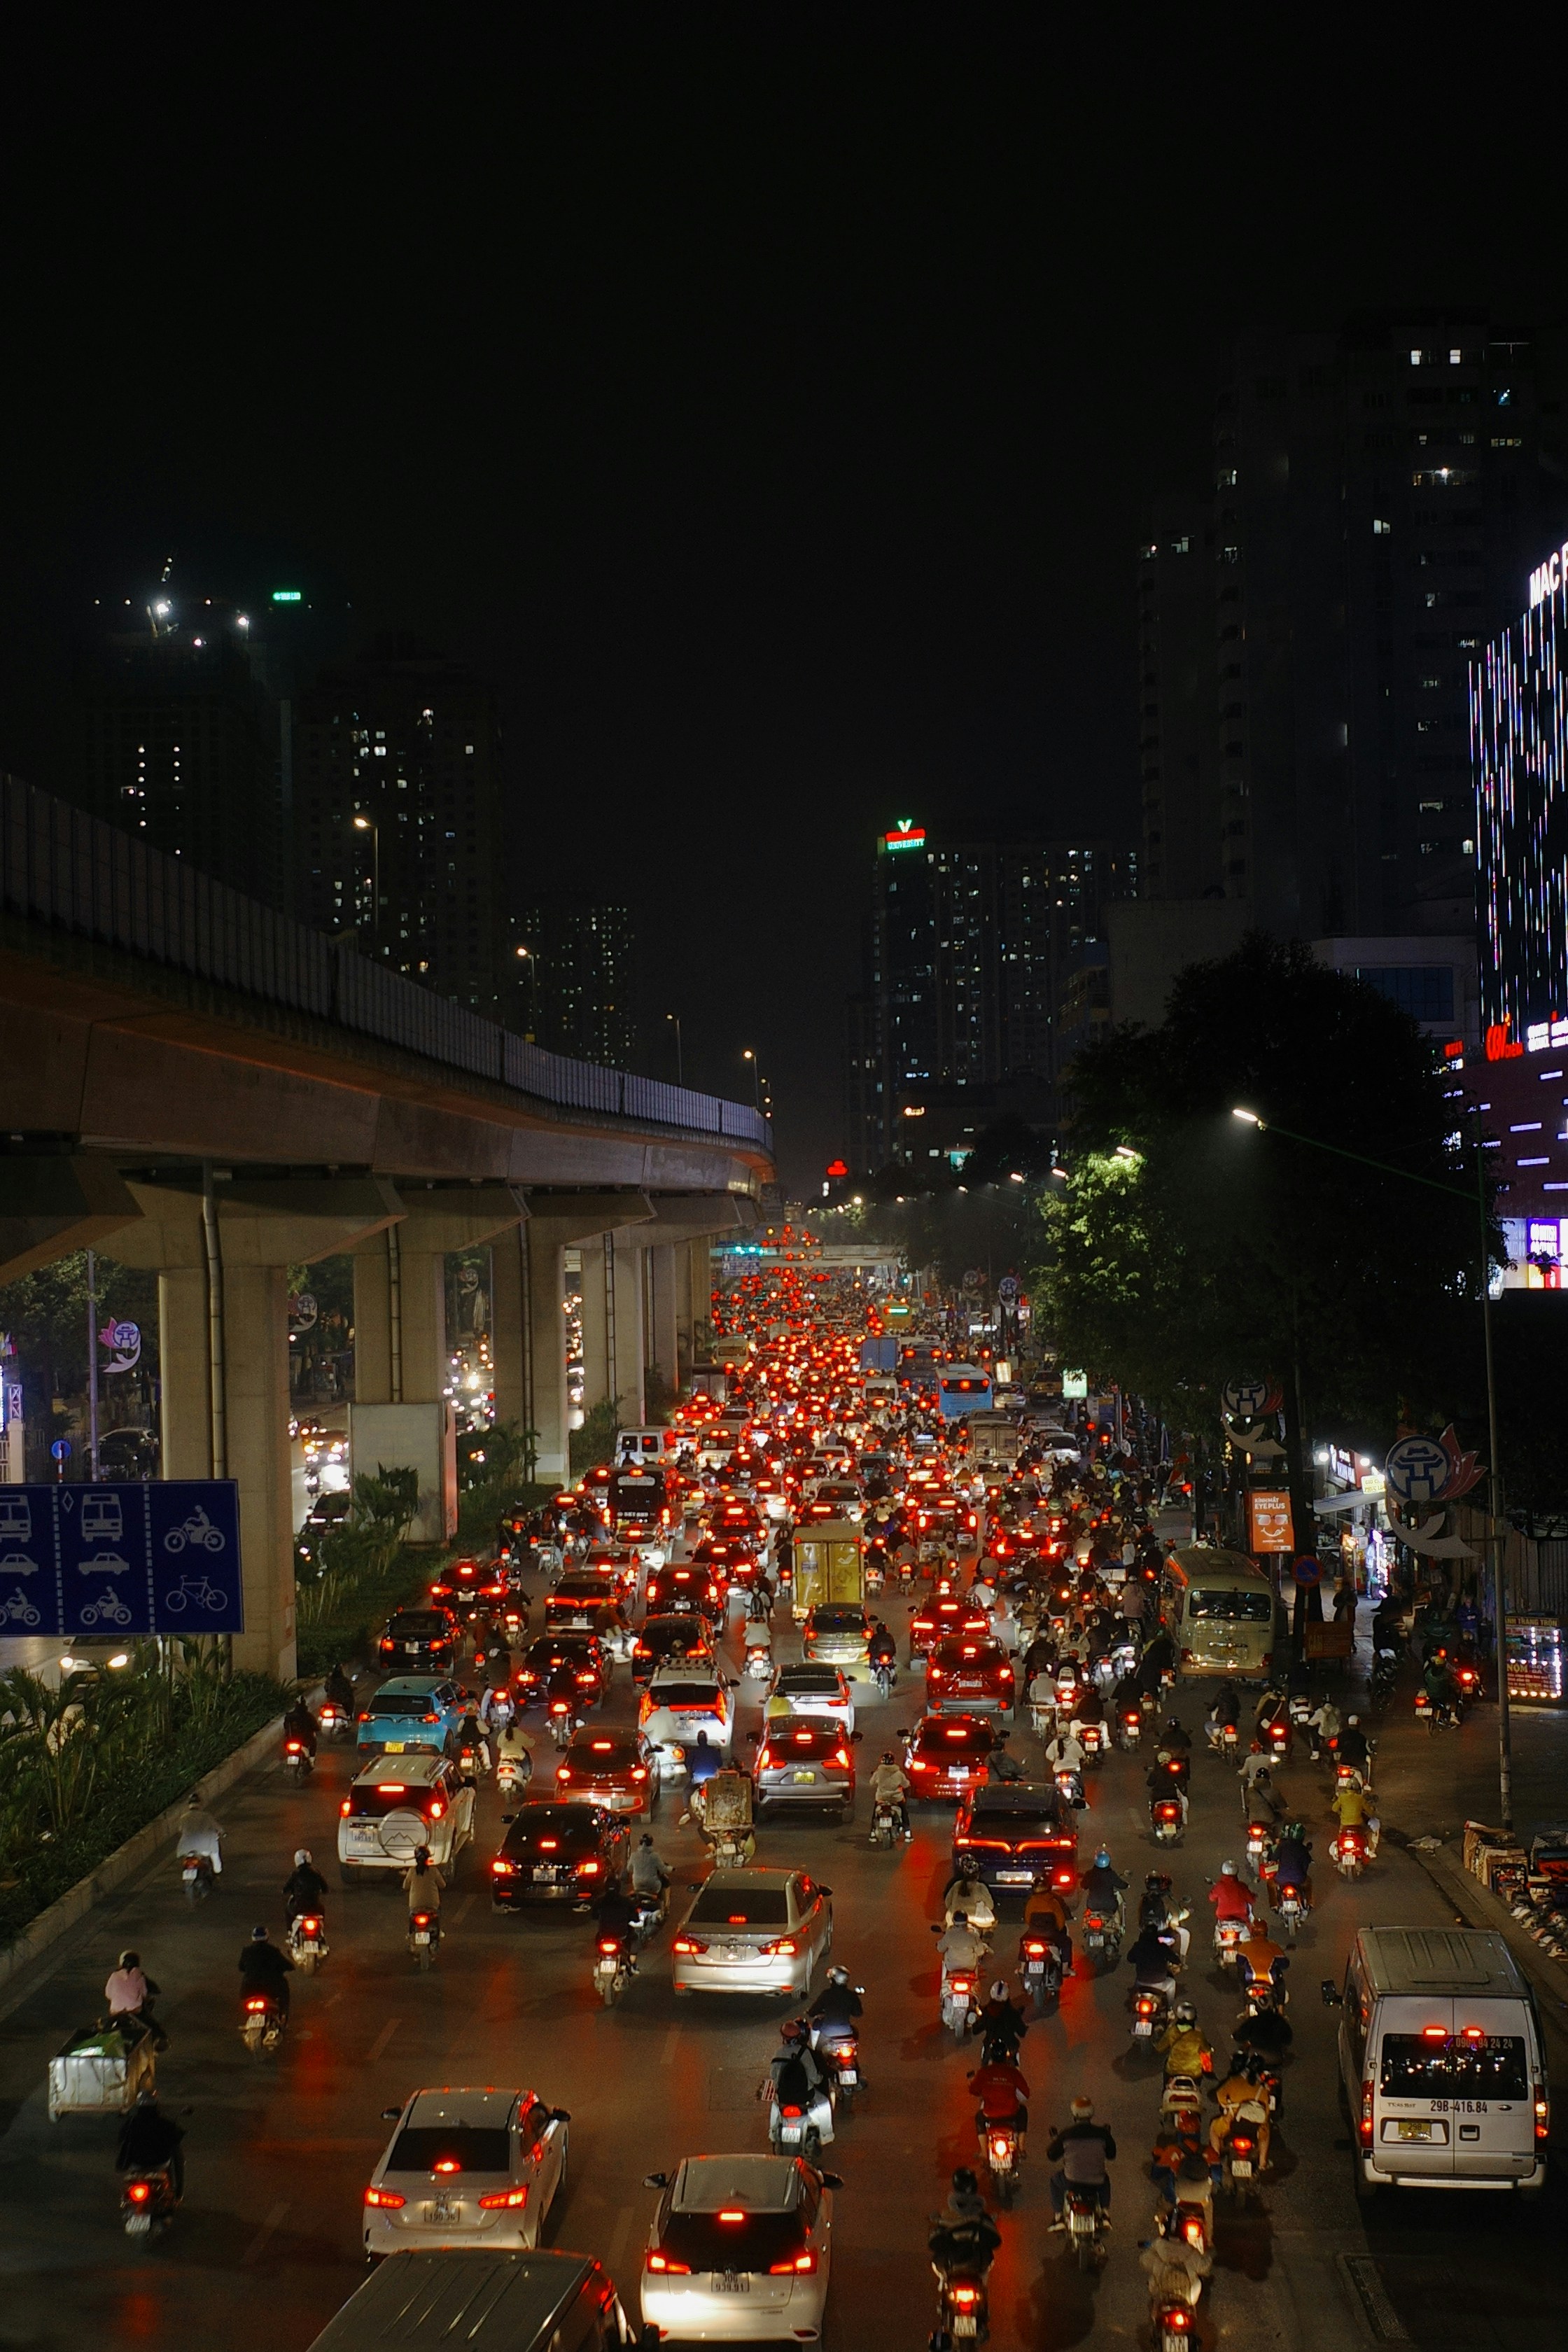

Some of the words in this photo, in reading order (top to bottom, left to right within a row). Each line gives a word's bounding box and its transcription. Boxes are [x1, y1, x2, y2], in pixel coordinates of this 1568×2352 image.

[1530, 552, 1560, 609] MAC
[1478, 2037, 1488, 2049] 94
[1490, 2037, 1501, 2050] 24
[1503, 2037, 1513, 2050] 24
[1430, 2099, 1488, 2113] 29B-416.84
